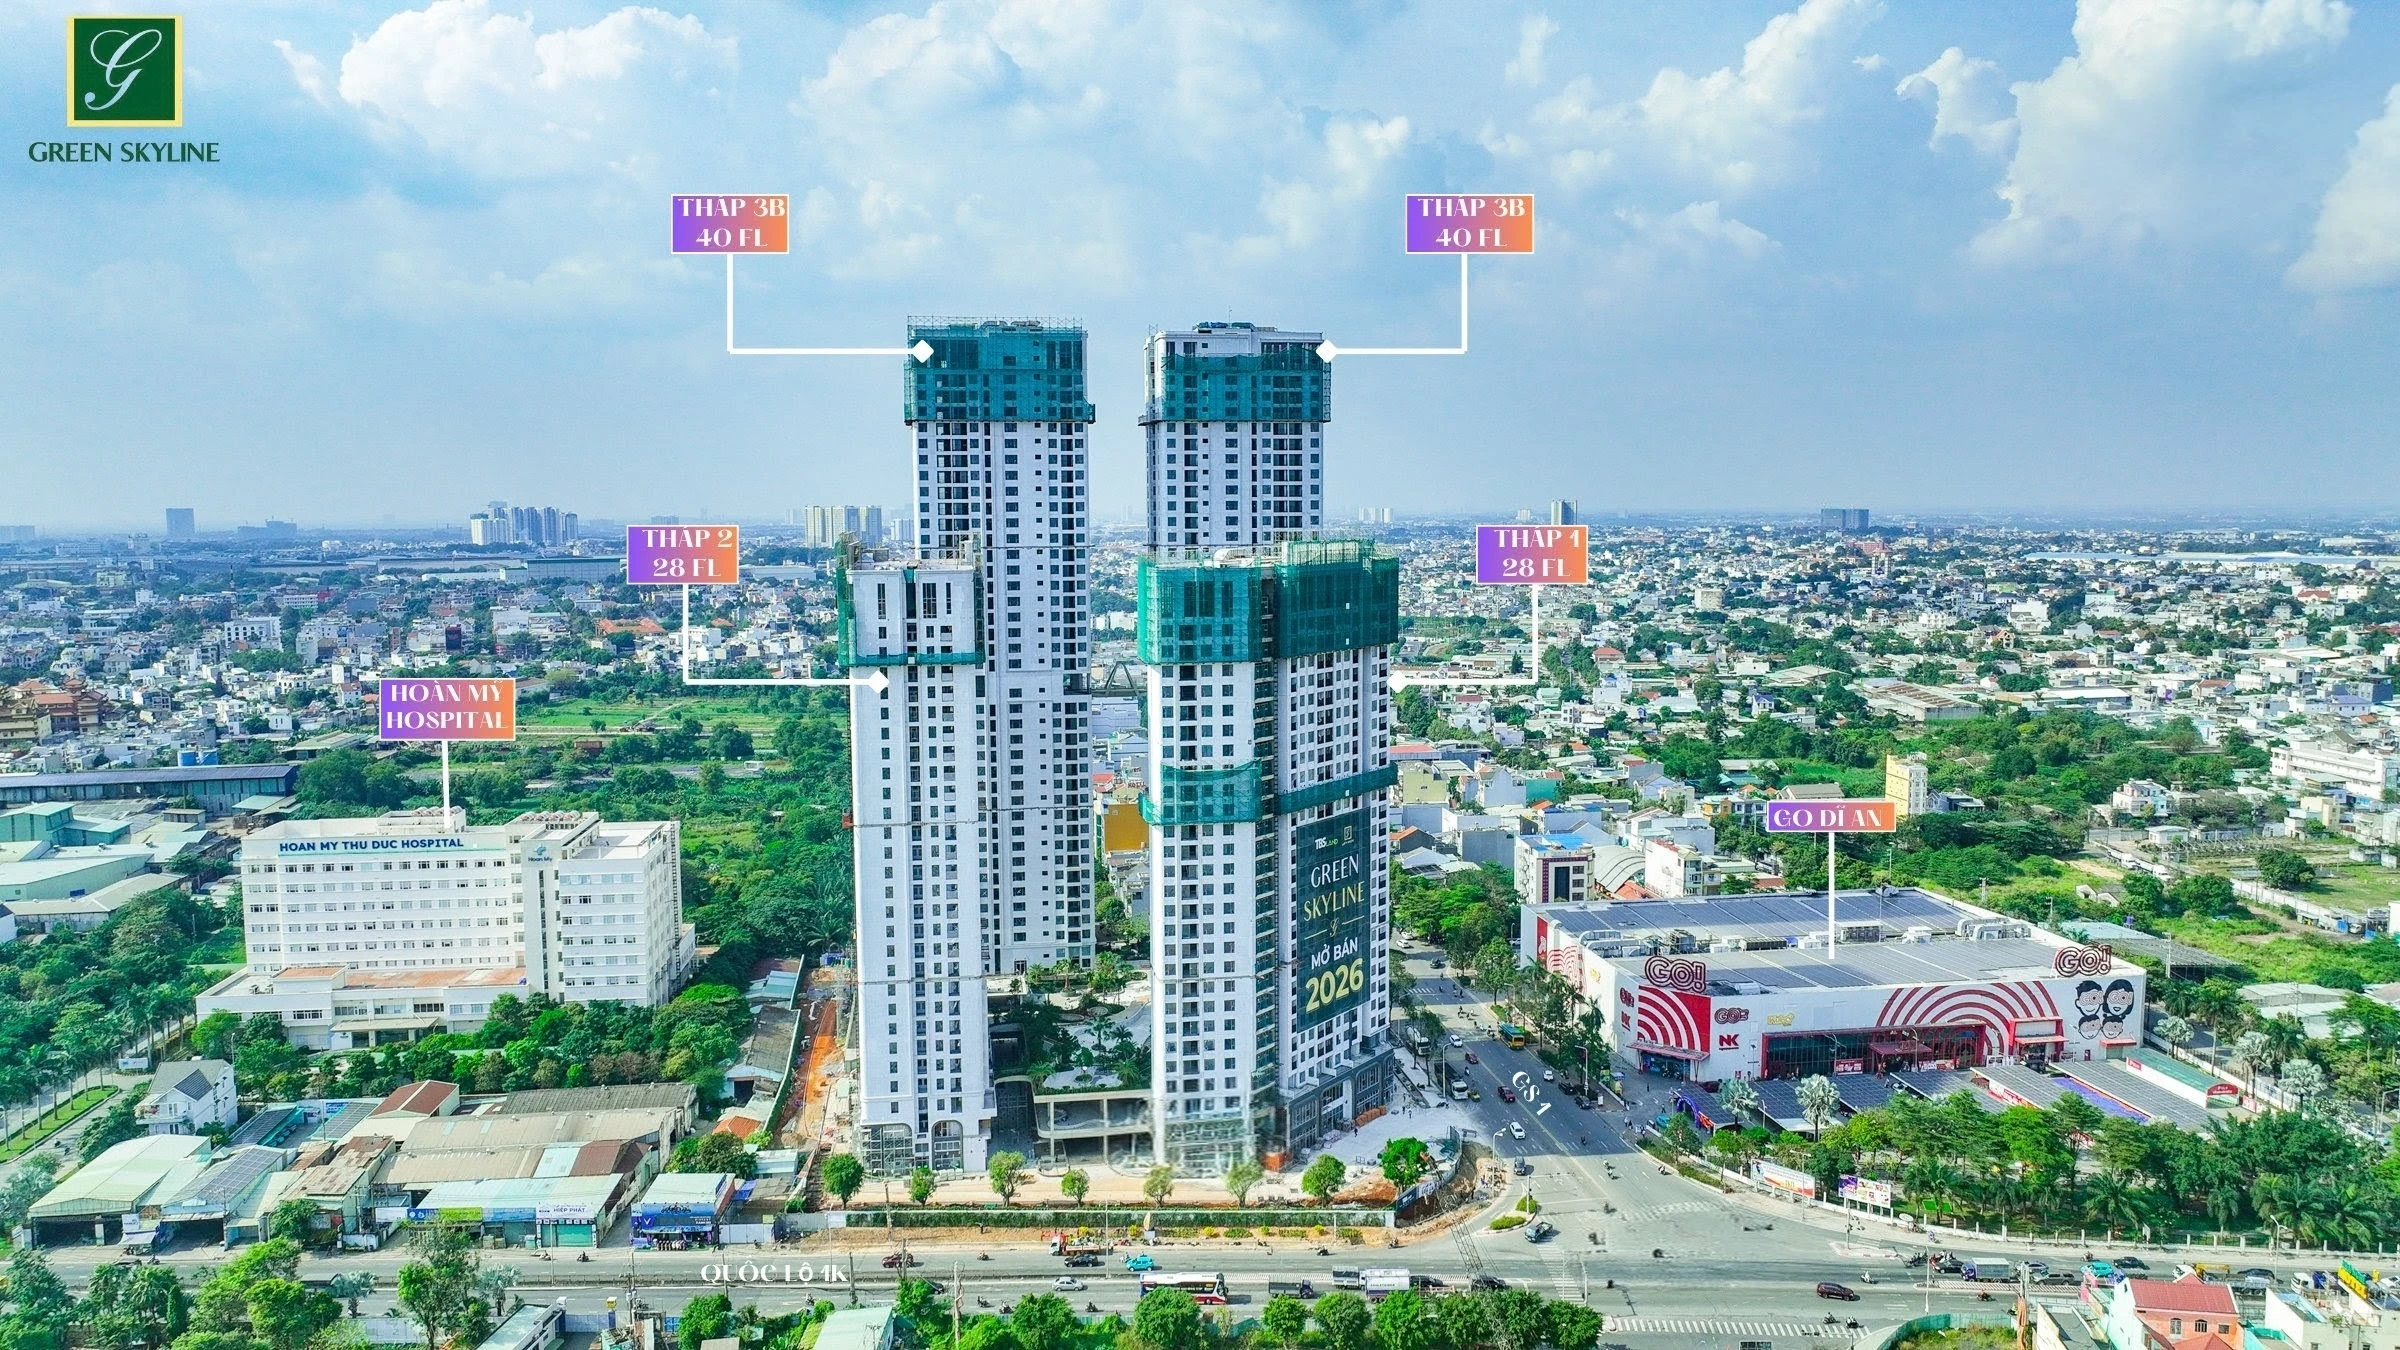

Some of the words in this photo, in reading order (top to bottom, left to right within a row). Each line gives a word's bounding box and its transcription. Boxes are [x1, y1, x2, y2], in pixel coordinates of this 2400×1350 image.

[279, 842, 316, 852] HOAN
[320, 841, 338, 851] MY
[342, 840, 368, 850] THU
[372, 839, 398, 850] DUC
[401, 837, 464, 849] HOSPITAL
[1310, 853, 1359, 888] GREEN
[1303, 880, 1365, 921] SKYLINE
[1311, 943, 1330, 970] MỞ
[1333, 936, 1358, 961] BÁN
[2055, 945, 2112, 977] GO!
[1305, 957, 1364, 1014] 2026
[1645, 956, 1706, 994] GO!
[1719, 1034, 1739, 1047] NK
